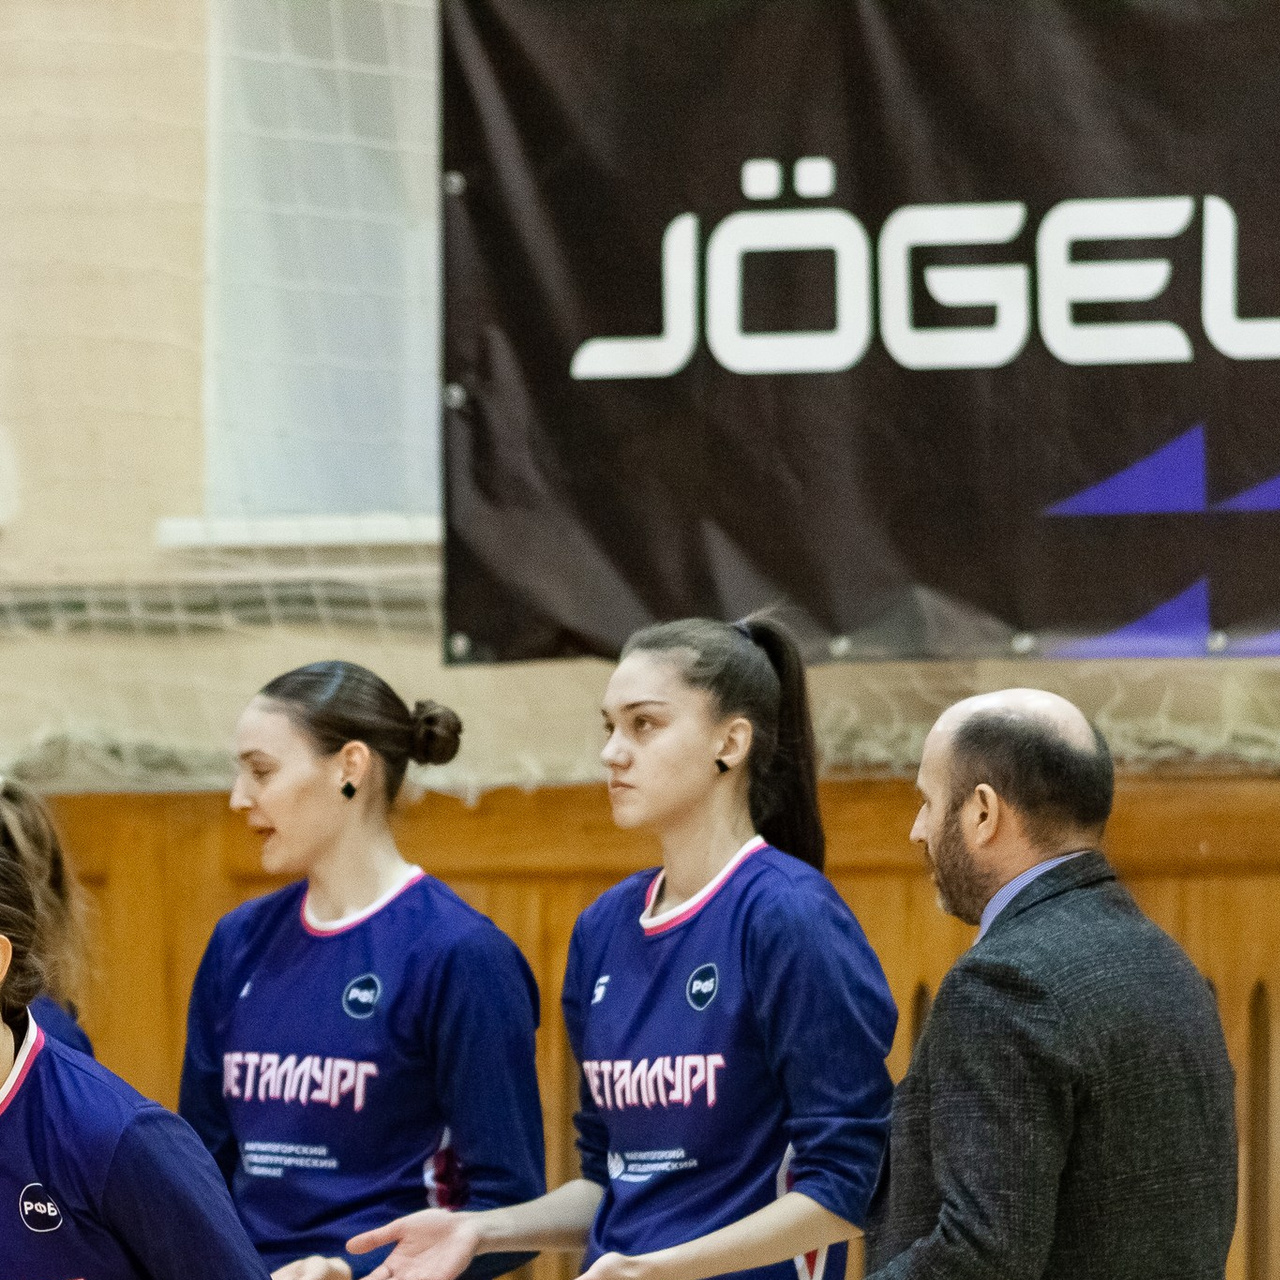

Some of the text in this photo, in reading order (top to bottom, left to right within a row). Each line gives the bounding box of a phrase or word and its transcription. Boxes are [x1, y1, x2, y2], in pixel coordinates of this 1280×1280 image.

[569, 157, 1280, 380] JÖGEL
[223, 1051, 379, 1112] ЕТАЛЛУРГ
[23, 1201, 58, 1217] РФБ
